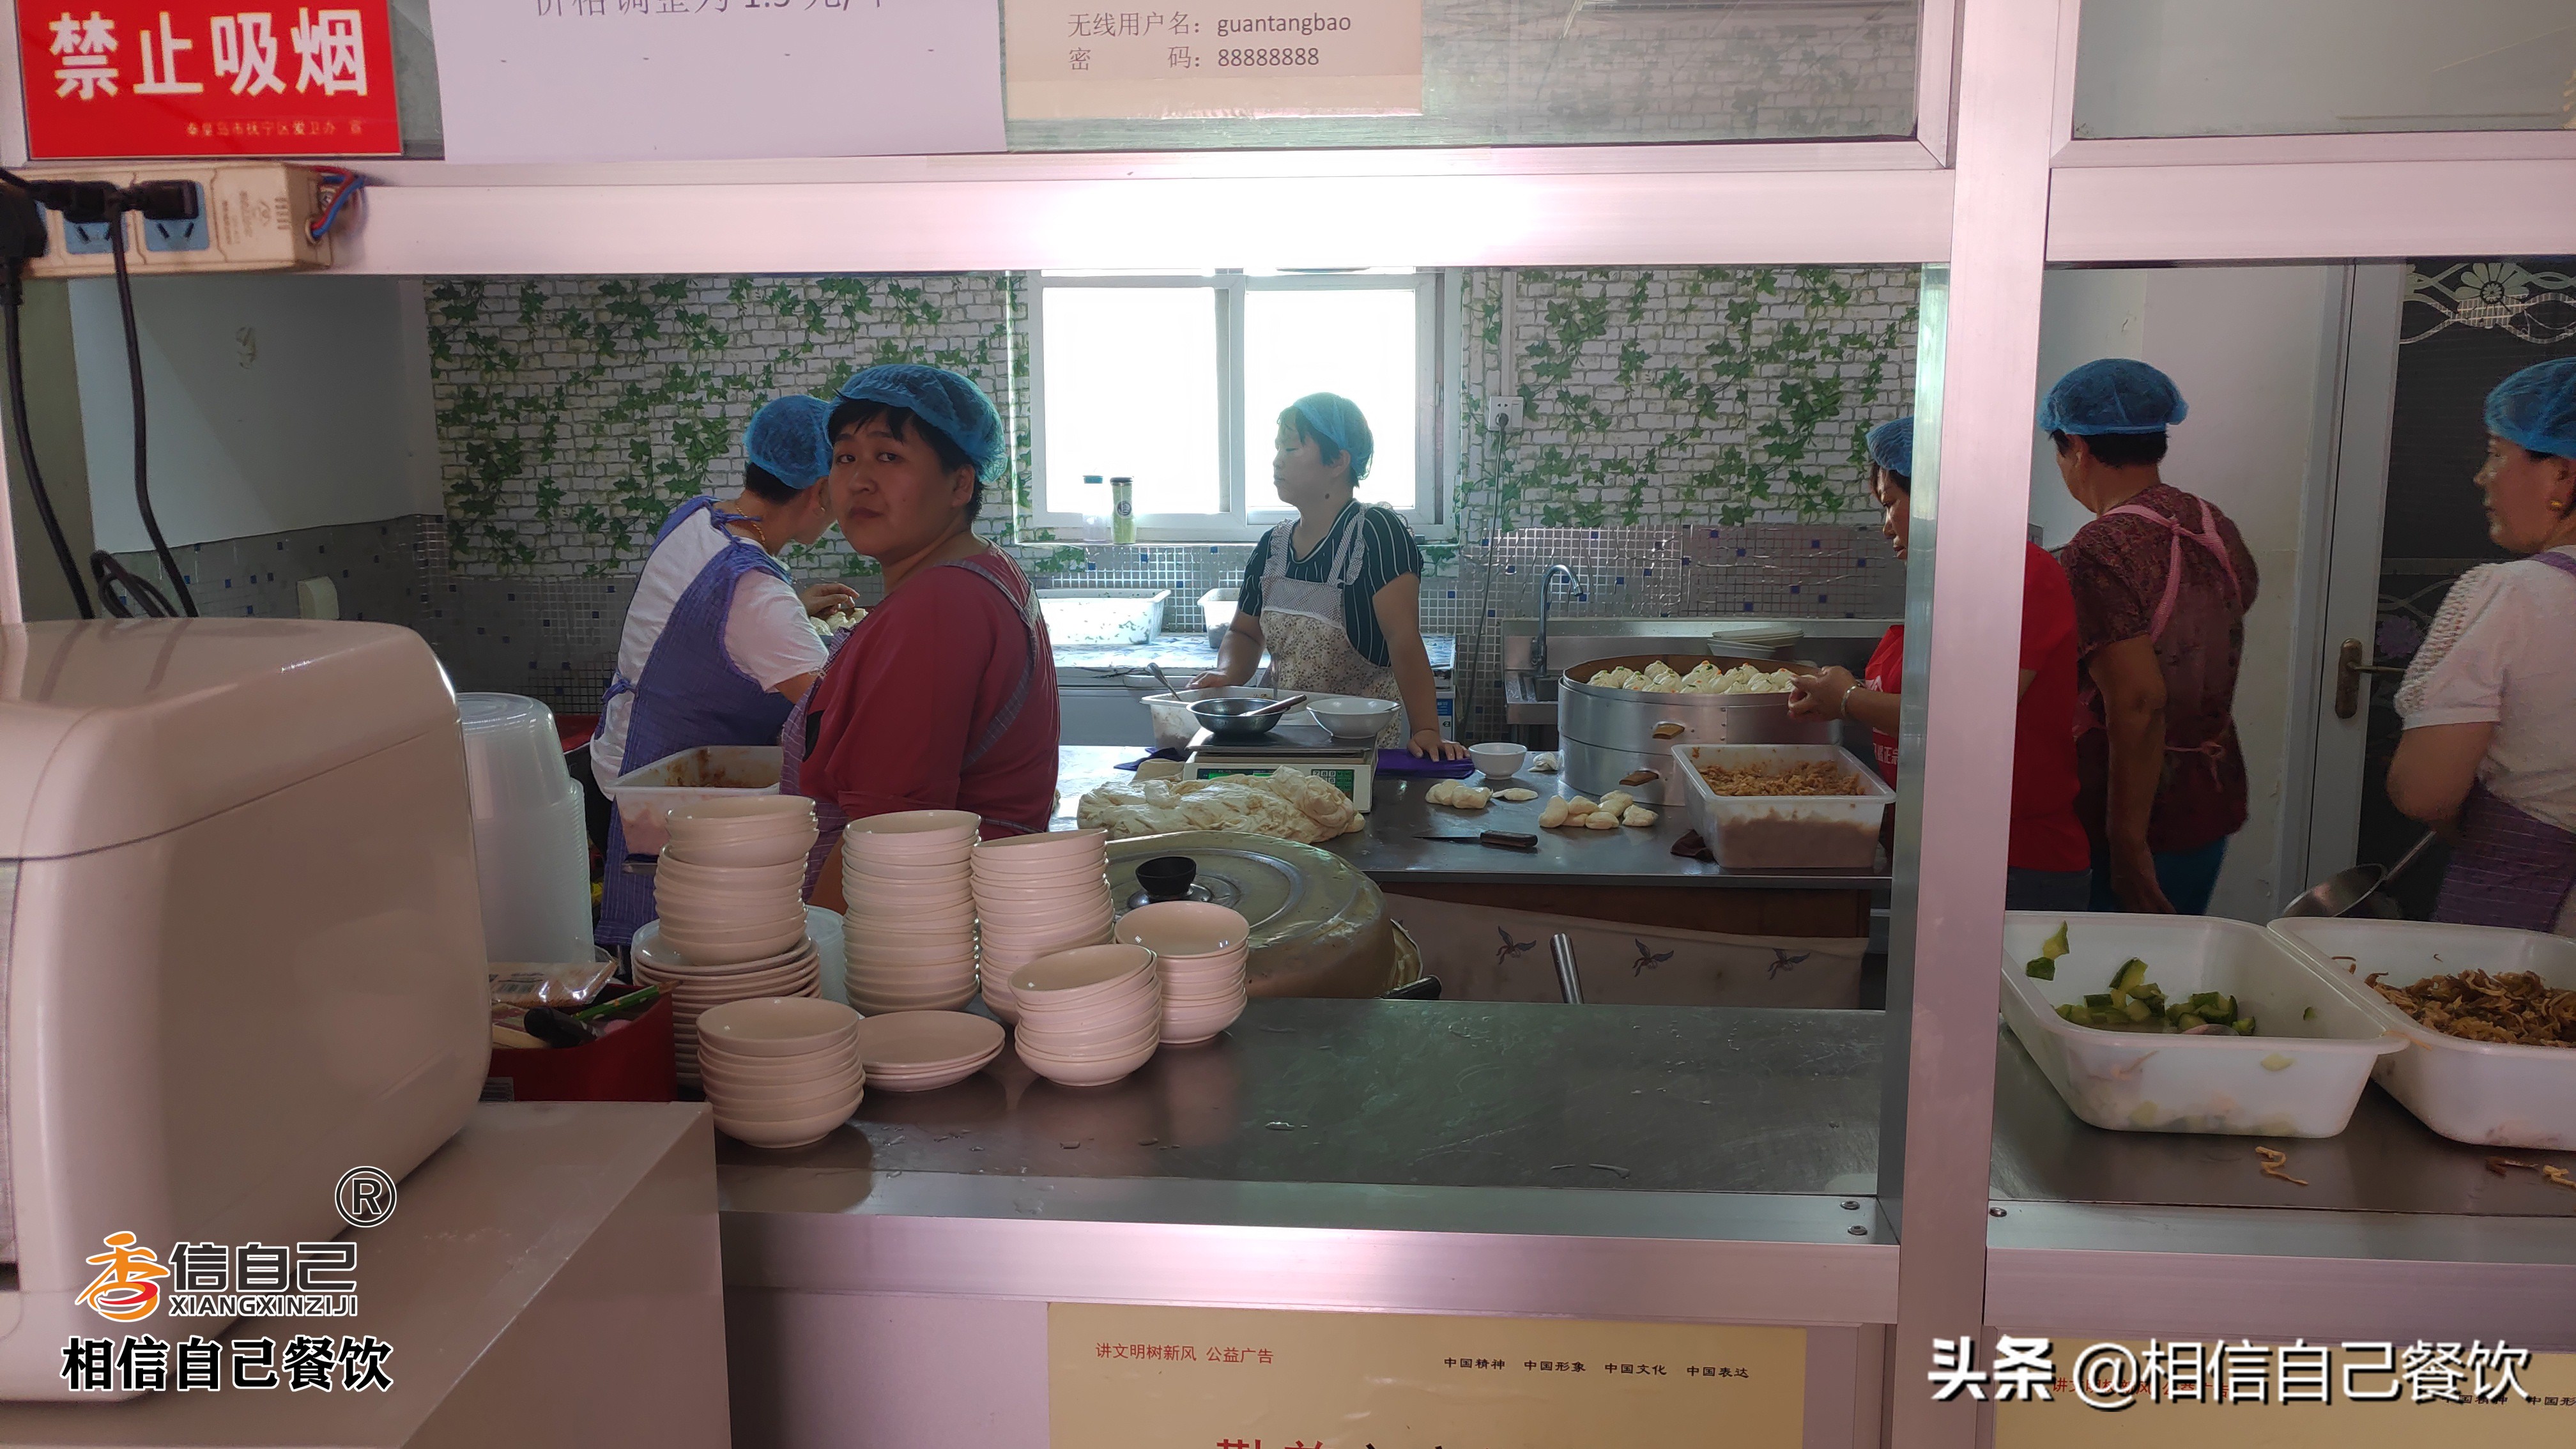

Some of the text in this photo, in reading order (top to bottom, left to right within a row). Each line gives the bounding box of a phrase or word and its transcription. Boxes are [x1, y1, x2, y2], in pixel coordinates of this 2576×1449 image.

[1068, 11, 1351, 37] 无线用户名： guantangbao
[49, 7, 367, 100] 禁止吸烟
[1068, 47, 1091, 70] 密
[1218, 48, 1319, 66] 88888888
[1095, 1342, 1274, 1364] 讲文明树新风 公益广告
[1444, 1357, 1749, 1379] 中国精神 中国形象 中国文化 中国表达
